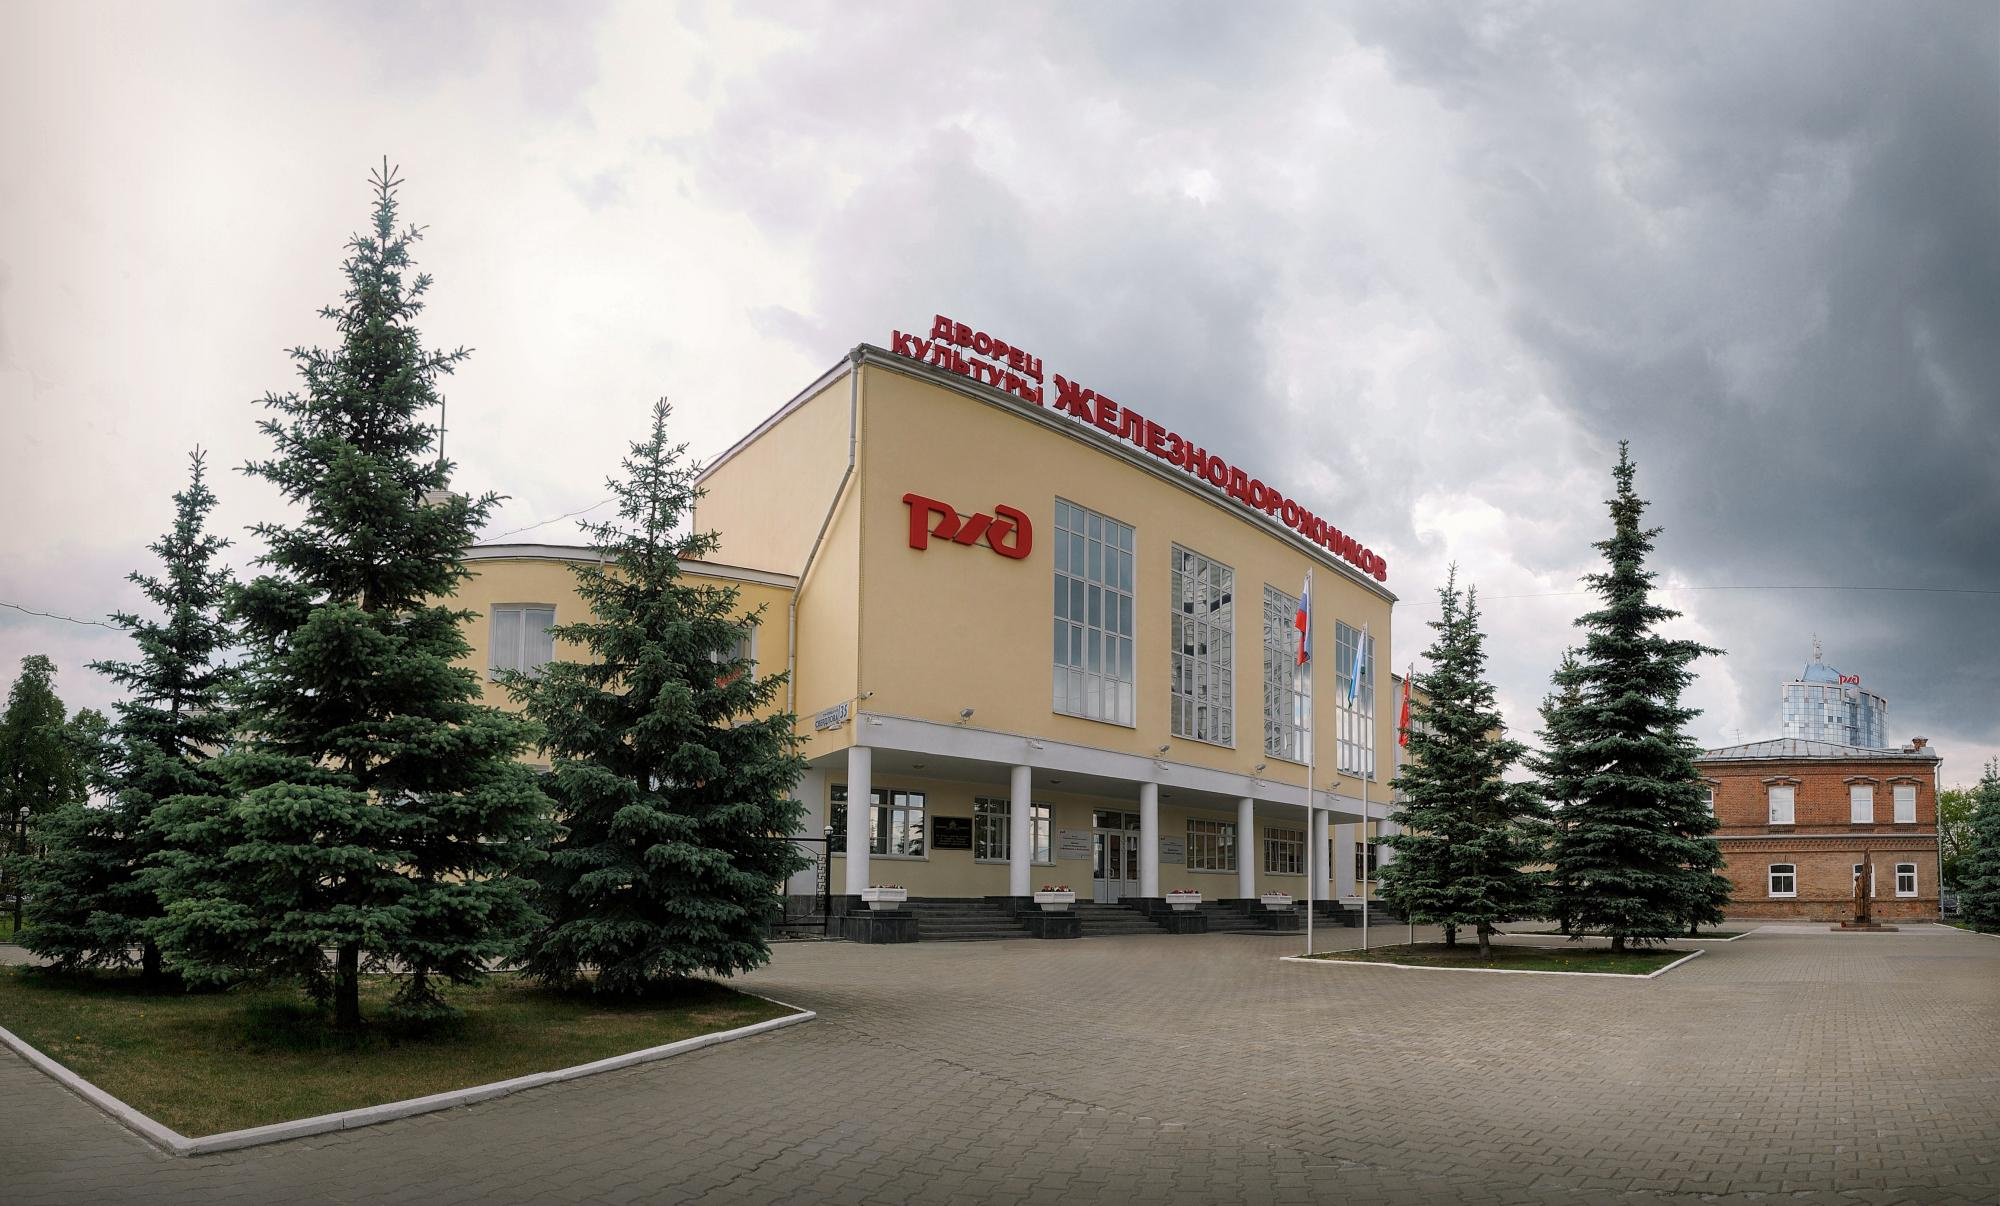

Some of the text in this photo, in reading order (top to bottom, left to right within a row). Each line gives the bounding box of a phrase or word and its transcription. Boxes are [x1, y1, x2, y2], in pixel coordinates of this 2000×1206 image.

[891, 330, 1044, 407] КУЛЬТУРЫ
[930, 314, 1044, 384] ДВОРЕЦ
[1053, 373, 1386, 582] ЖЕЛЕЗНОДОРОЖНИКОВ
[840, 704, 848, 718] 35
